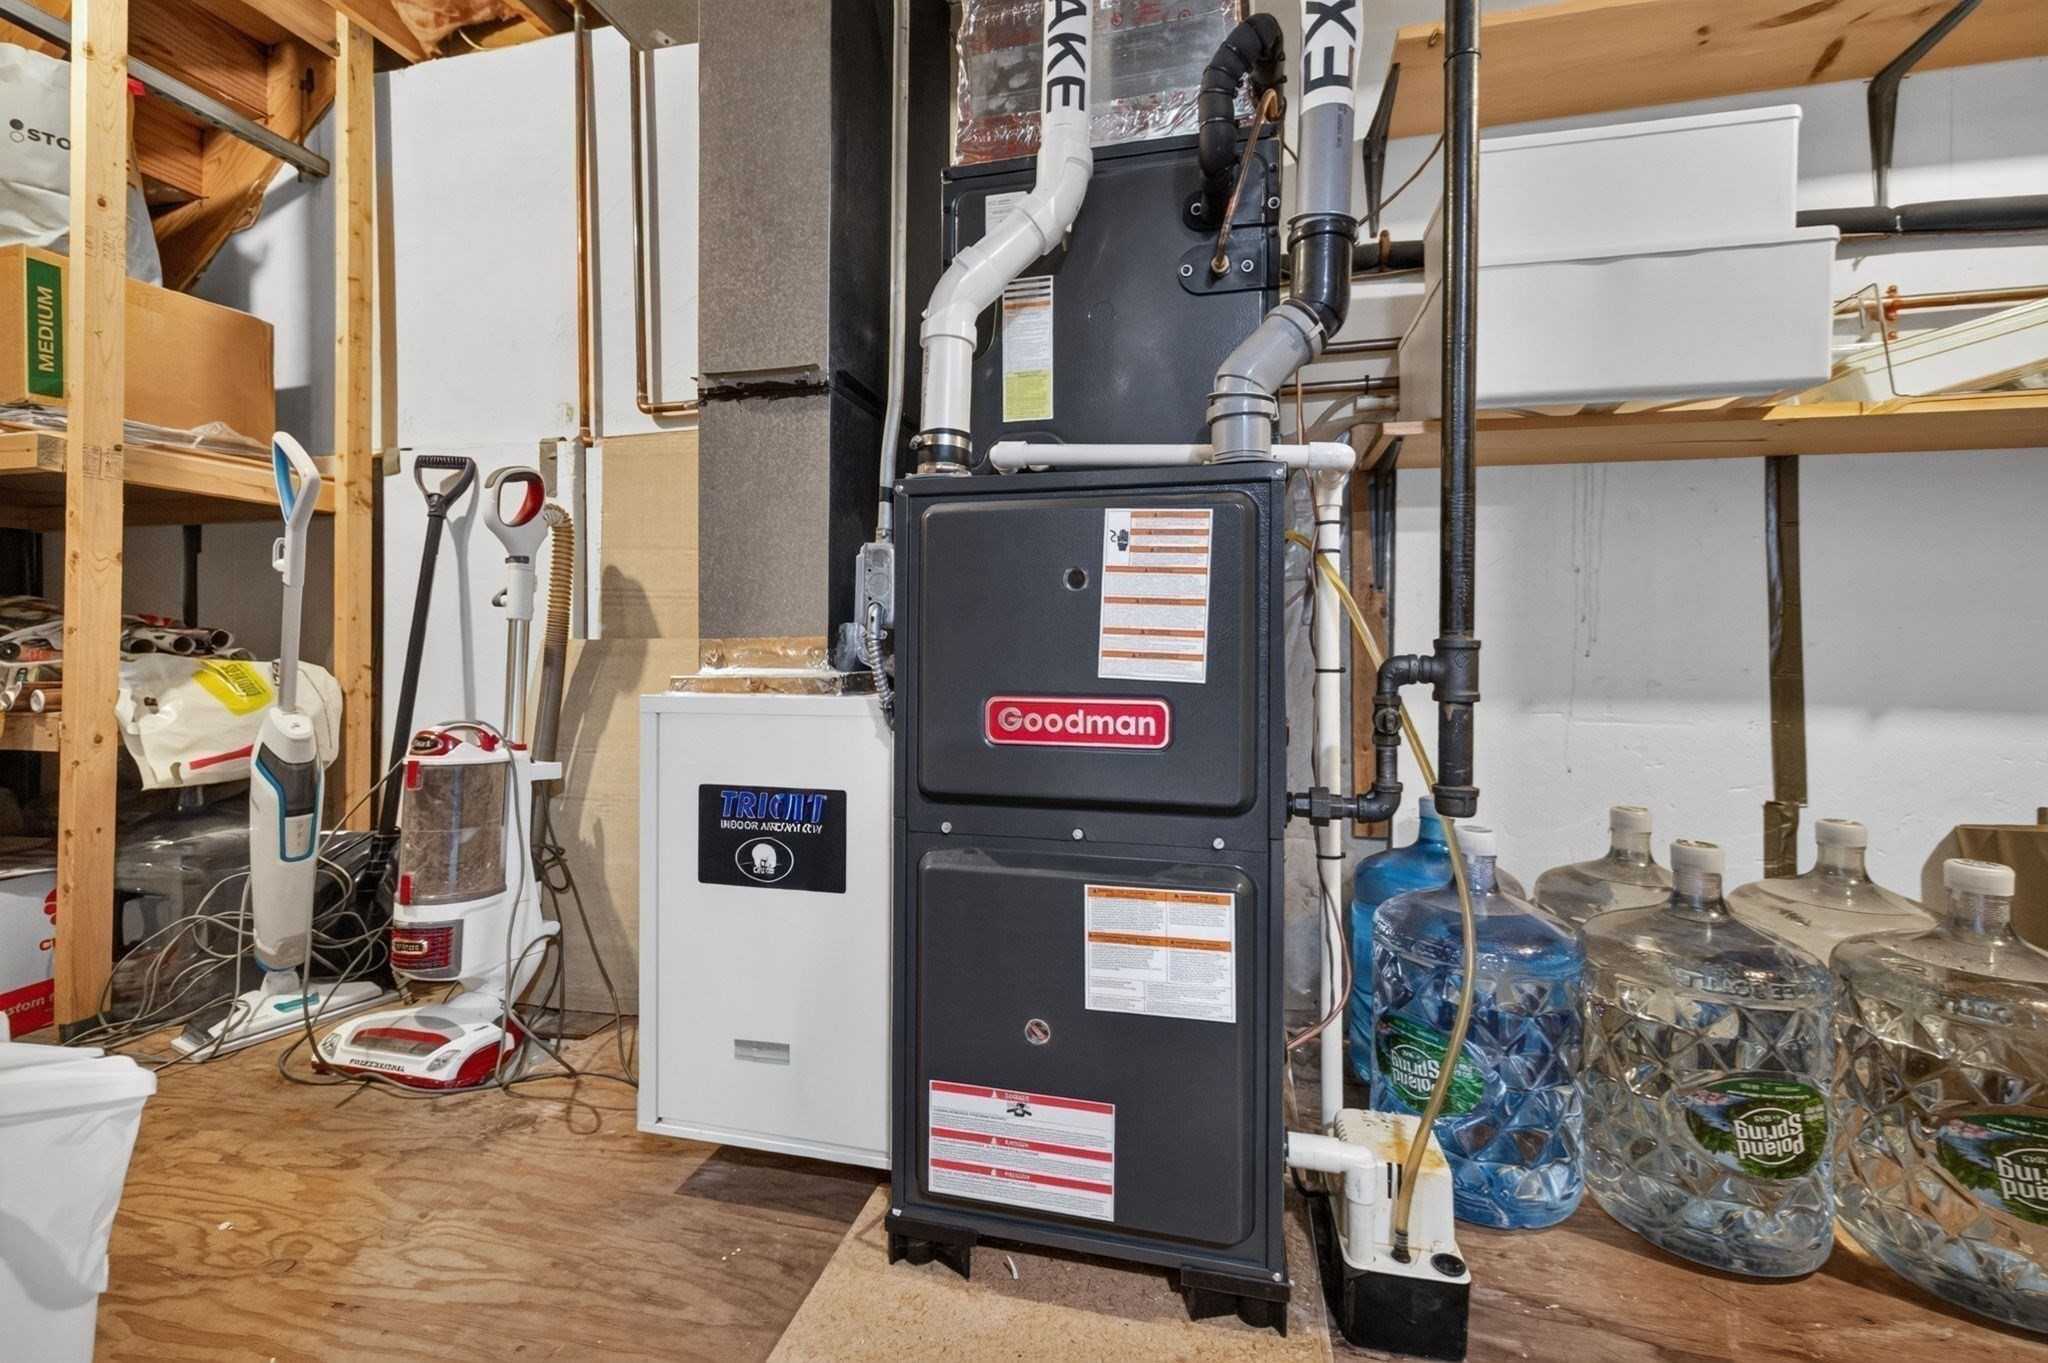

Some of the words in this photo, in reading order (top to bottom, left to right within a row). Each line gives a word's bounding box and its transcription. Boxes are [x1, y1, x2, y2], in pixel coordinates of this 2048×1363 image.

[37, 285, 55, 373] MEDIUM
[997, 707, 1157, 737] Goodman
[1392, 1067, 1436, 1093] oland
[1733, 1112, 1803, 1140] Spring
[1736, 1132, 1805, 1160] Poland
